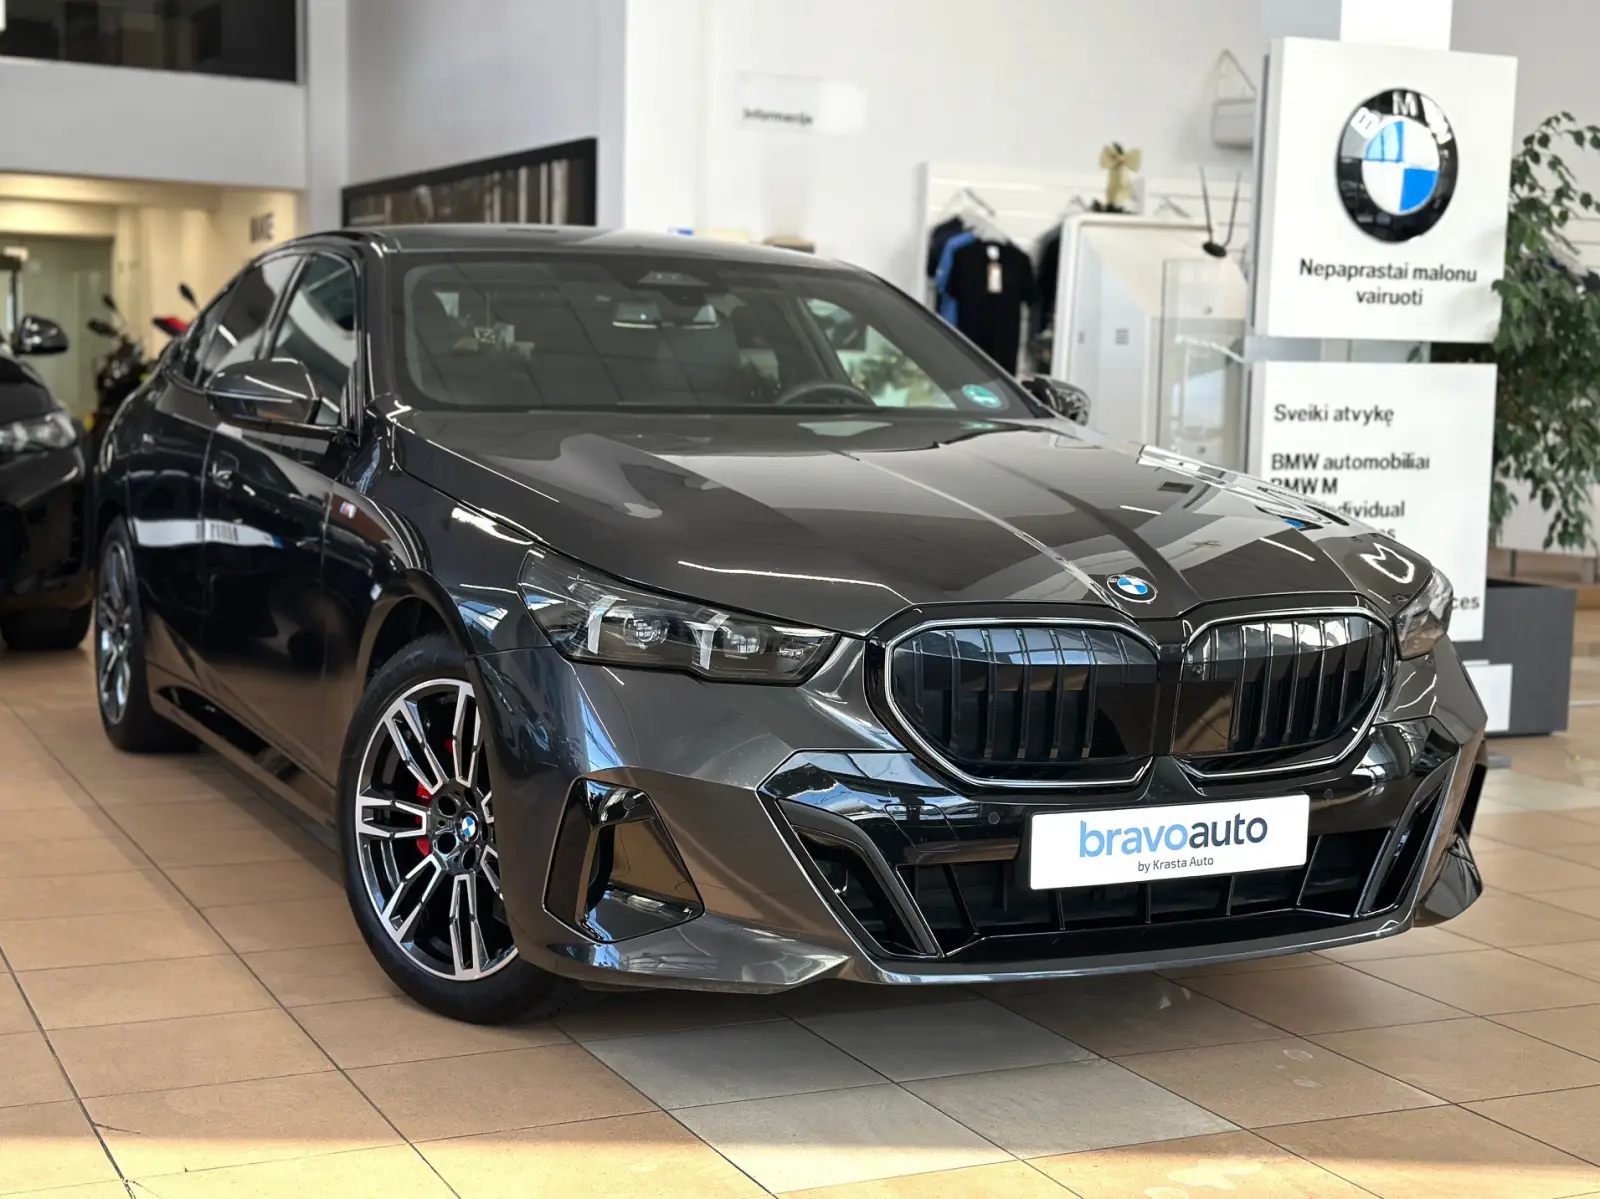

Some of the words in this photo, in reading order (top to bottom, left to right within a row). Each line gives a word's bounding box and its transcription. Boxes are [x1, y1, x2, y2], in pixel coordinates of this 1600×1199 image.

[1299, 258, 1409, 282] Nepaprastai
[1412, 262, 1478, 282] malonu
[1355, 287, 1424, 306] vairuoti
[1273, 403, 1329, 423] Sveiki
[1333, 405, 1395, 427] atvykę
[1271, 453, 1320, 471] BMW
[1323, 452, 1430, 471] automobiliai
[1321, 477, 1338, 495] M
[1322, 500, 1406, 518] dividual
[1079, 813, 1267, 857] bravoauto
[1137, 861, 1151, 873] by
[1152, 857, 1188, 869] Krasta
[1189, 856, 1214, 867] Auto
